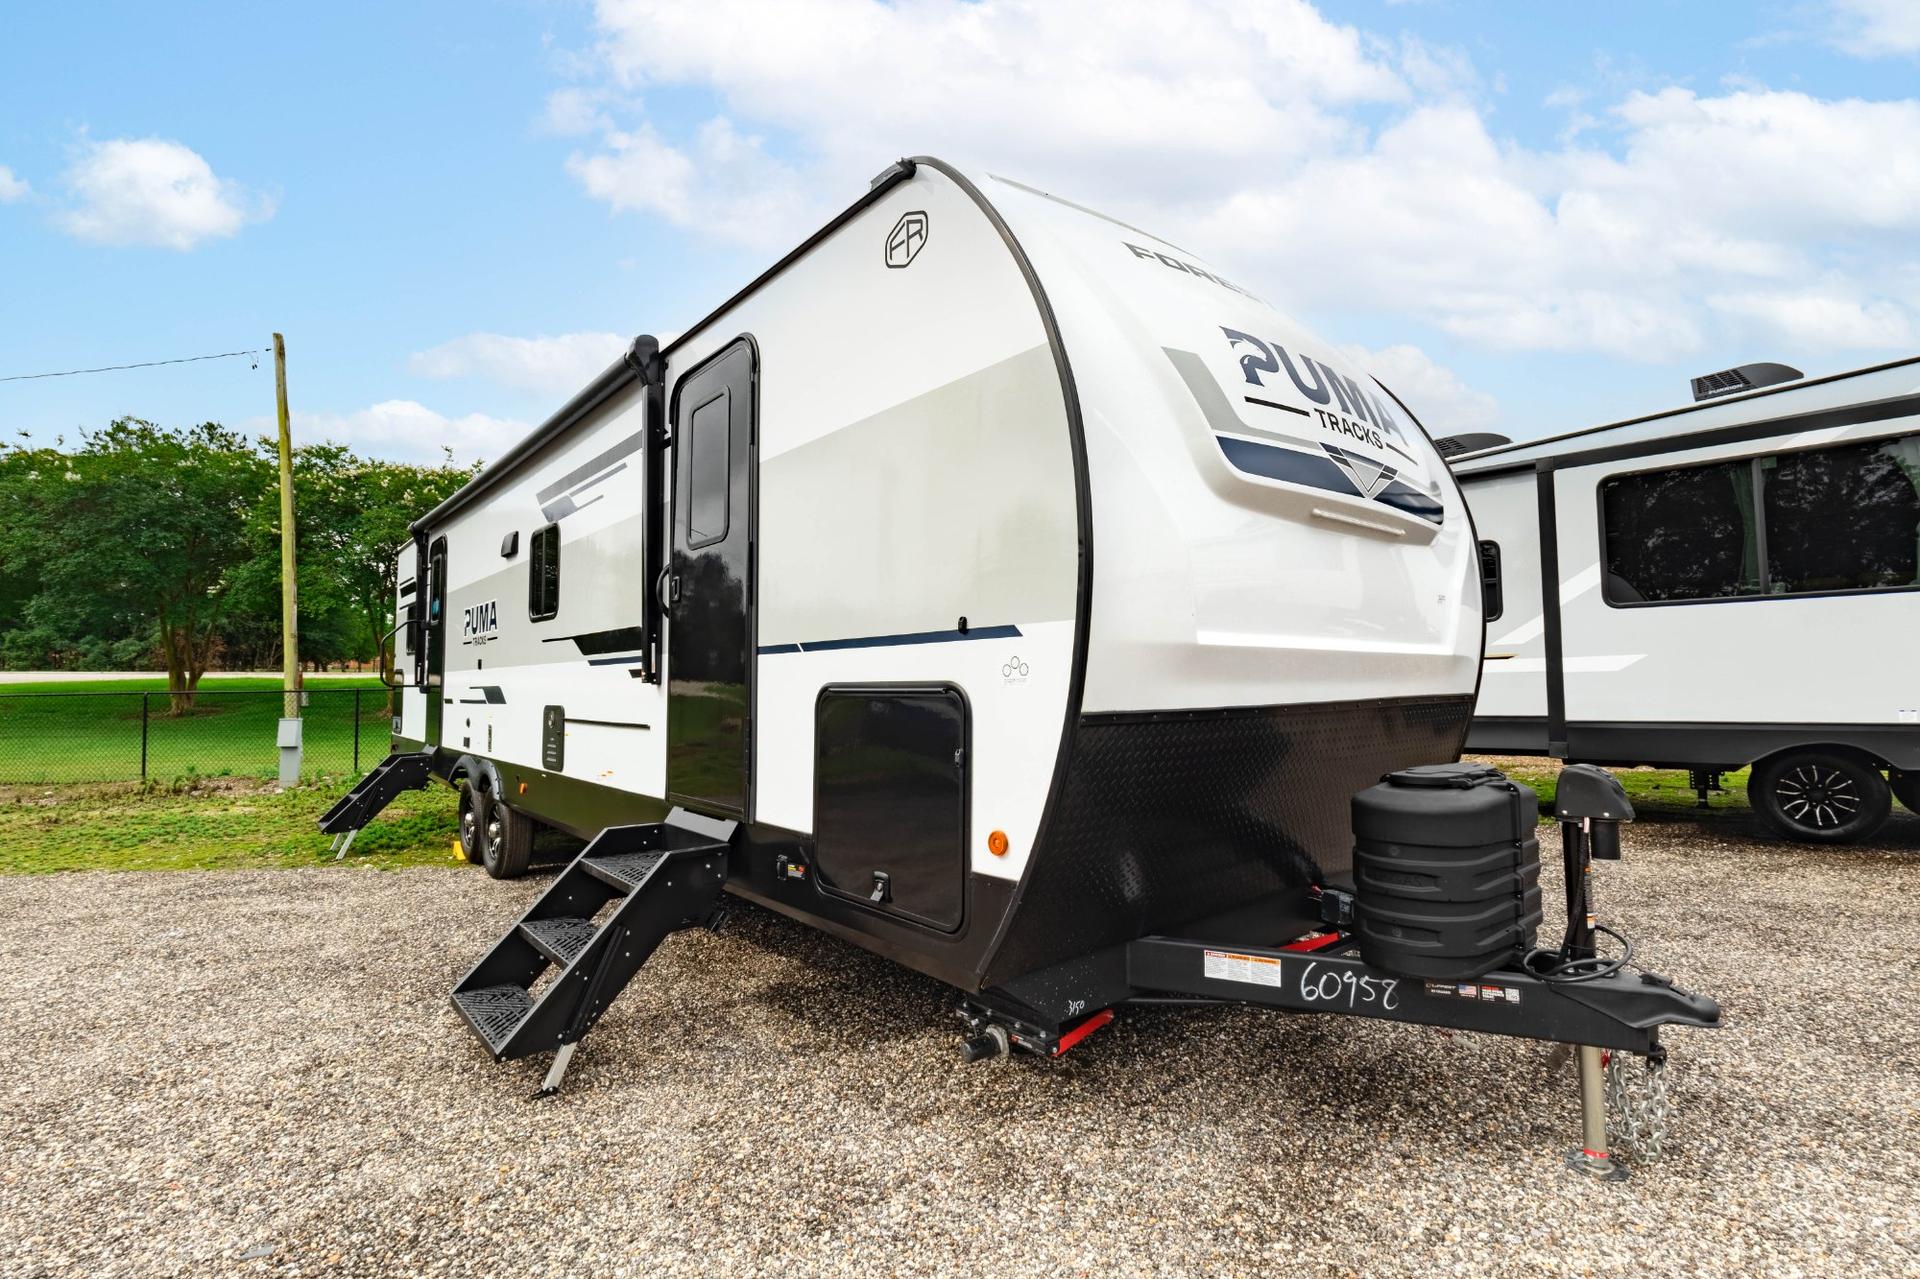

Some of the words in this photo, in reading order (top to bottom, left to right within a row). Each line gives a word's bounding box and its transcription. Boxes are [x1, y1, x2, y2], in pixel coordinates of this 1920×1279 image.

[1218, 325, 1409, 448] PUMA
[1313, 407, 1384, 450] TRACKS
[463, 600, 498, 637] PUMA
[1300, 961, 1400, 1010] 60958
